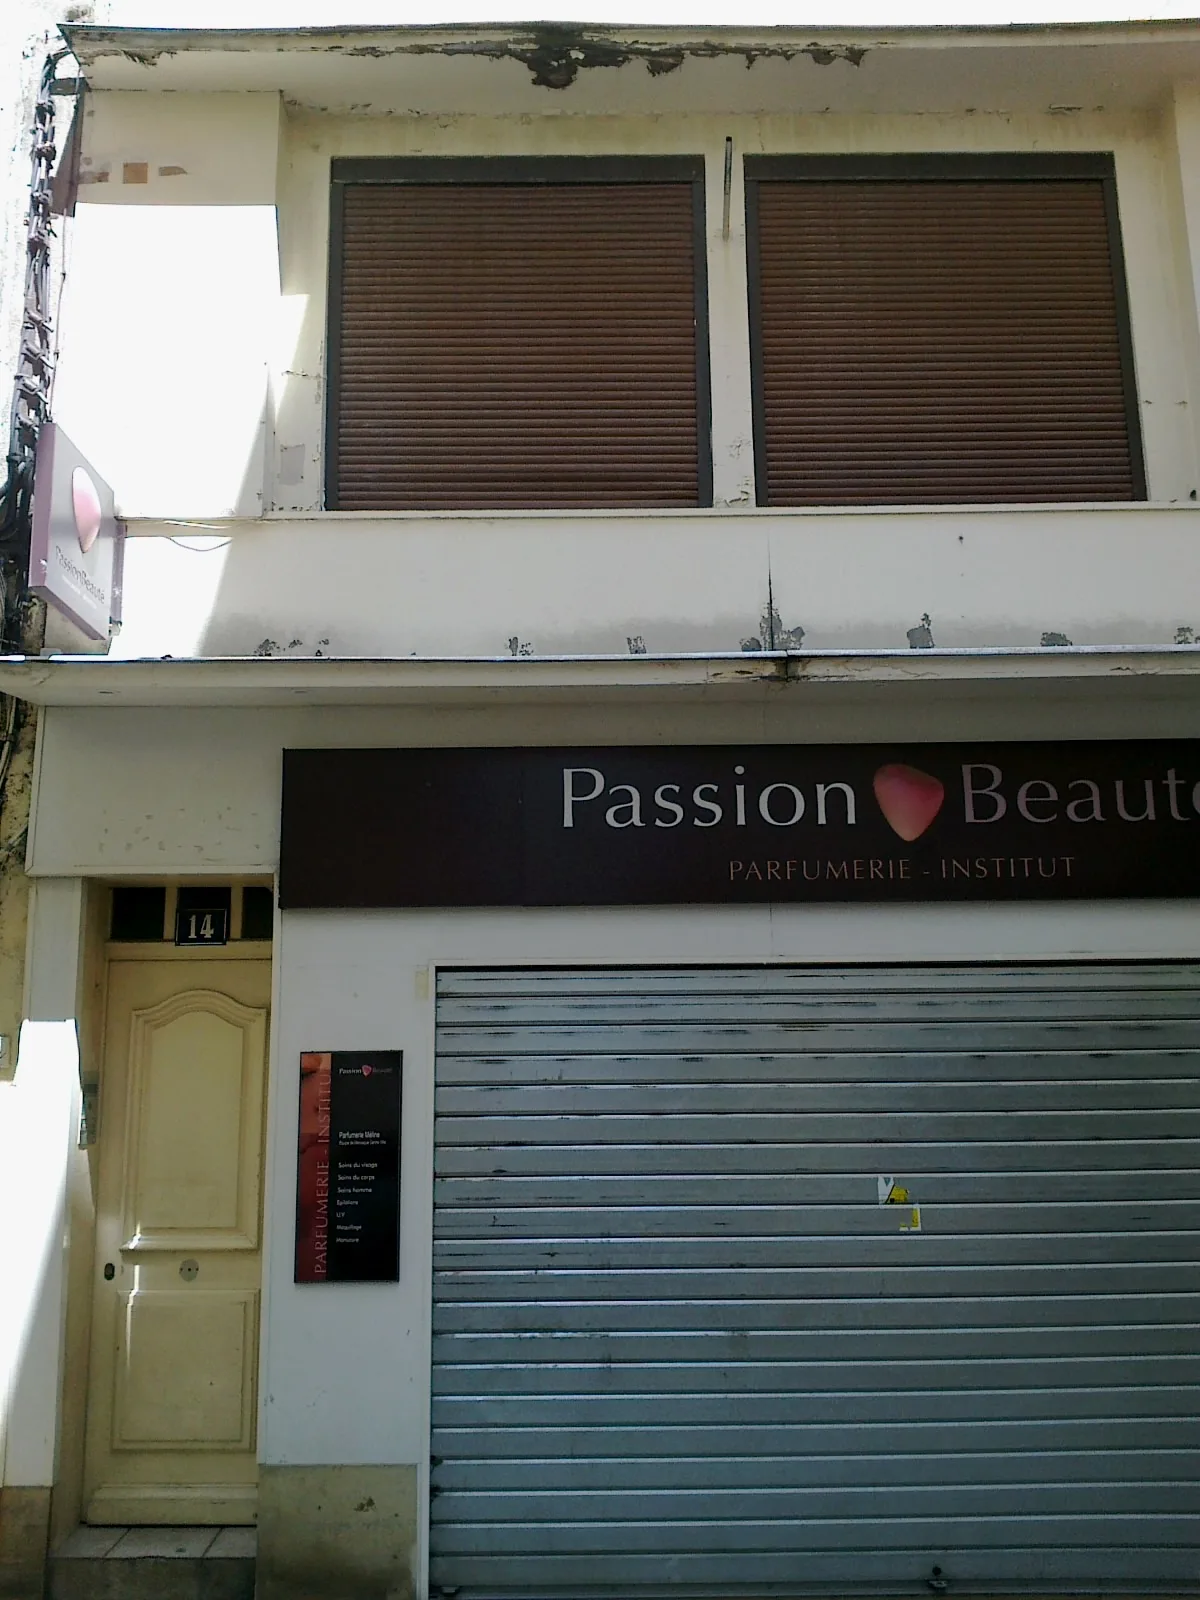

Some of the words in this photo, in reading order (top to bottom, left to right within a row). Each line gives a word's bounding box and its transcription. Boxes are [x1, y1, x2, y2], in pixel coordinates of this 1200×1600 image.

[562, 765, 857, 828] Passion
[962, 763, 1200, 824] Beaut
[728, 858, 912, 881] PARFUMERIE
[941, 856, 1076, 879] INSTITUT
[188, 913, 214, 939] 14
[314, 1161, 329, 1274] PARFUMERIE
